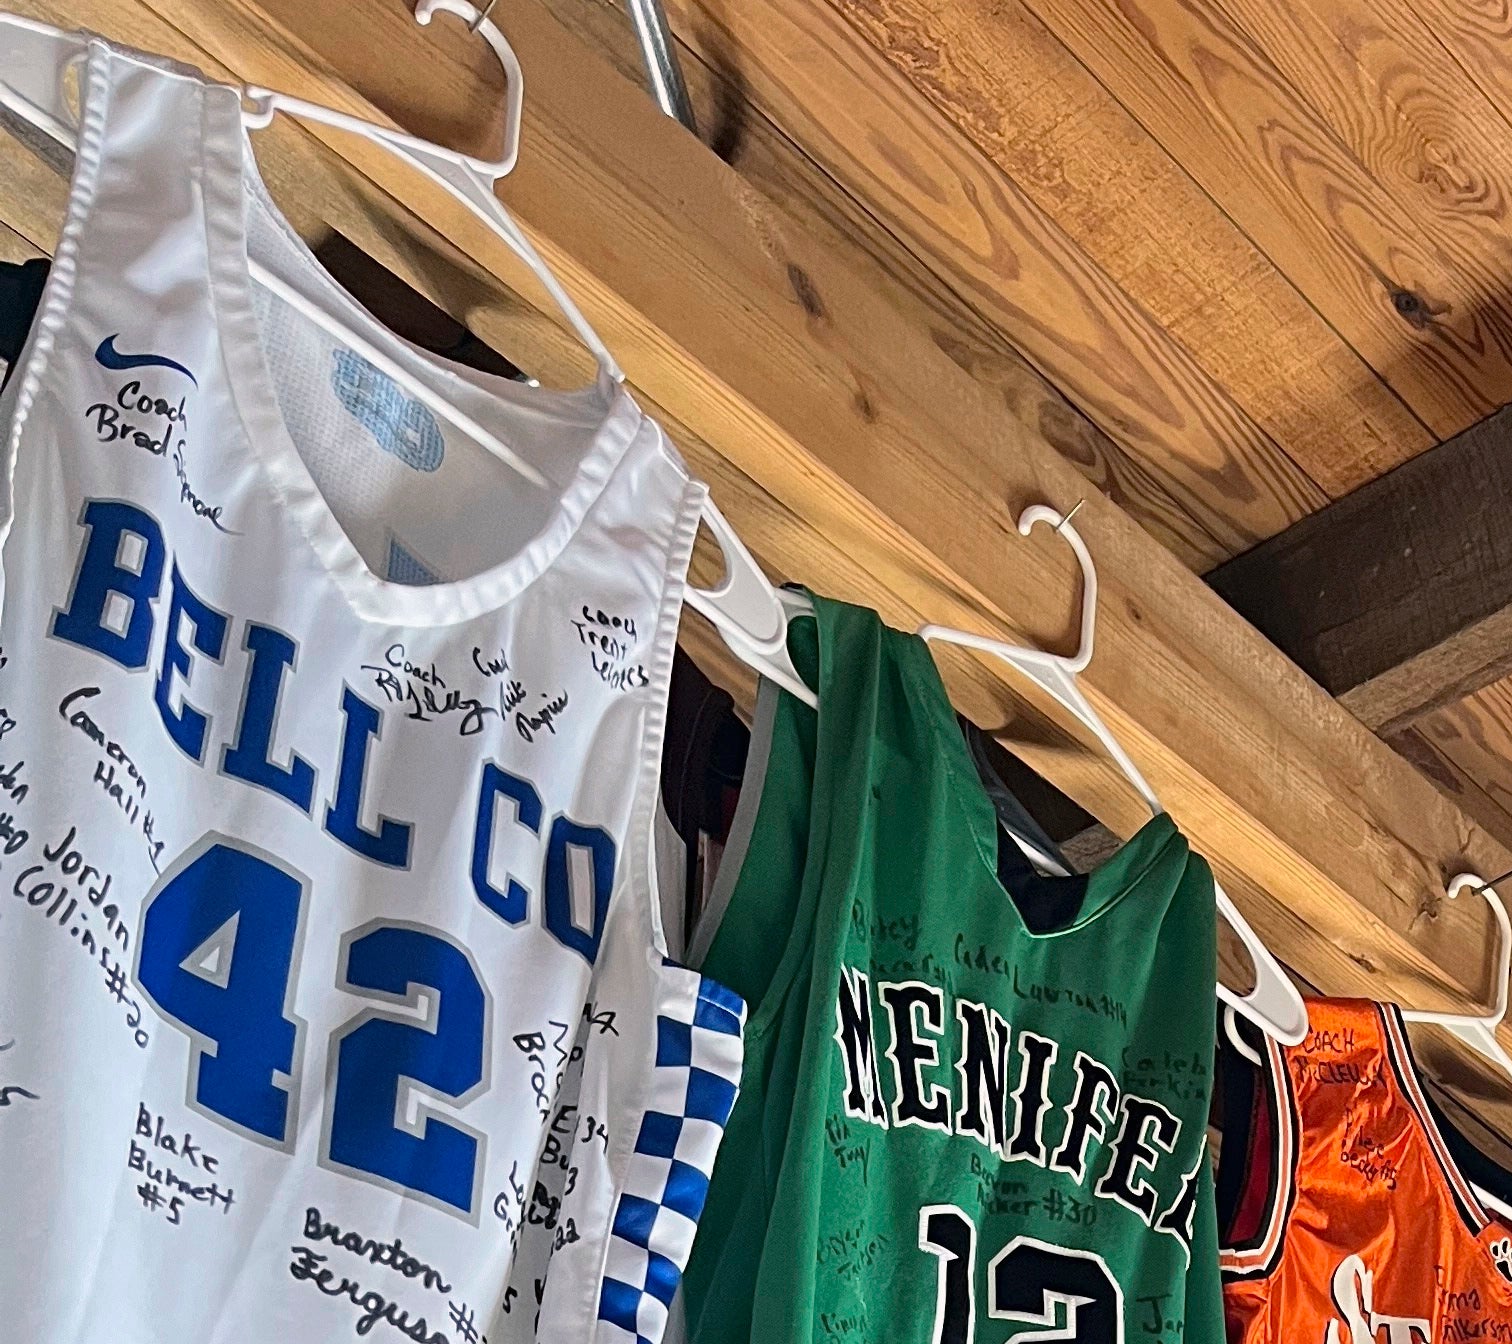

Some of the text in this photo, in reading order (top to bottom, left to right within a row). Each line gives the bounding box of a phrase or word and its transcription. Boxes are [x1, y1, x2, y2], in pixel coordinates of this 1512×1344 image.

[86, 403, 171, 457] Brad
[116, 380, 188, 431] Coach
[47, 497, 415, 872] BELL
[386, 643, 447, 689] Coach
[93, 760, 139, 825] Hall
[14, 865, 111, 968] Collins
[43, 826, 130, 952] Jordan
[132, 829, 493, 1228] 42
[135, 1101, 220, 1175] Blake
[127, 1142, 236, 1213] Burnett
[137, 1182, 185, 1225] #5
[303, 1207, 453, 1295] Braxton
